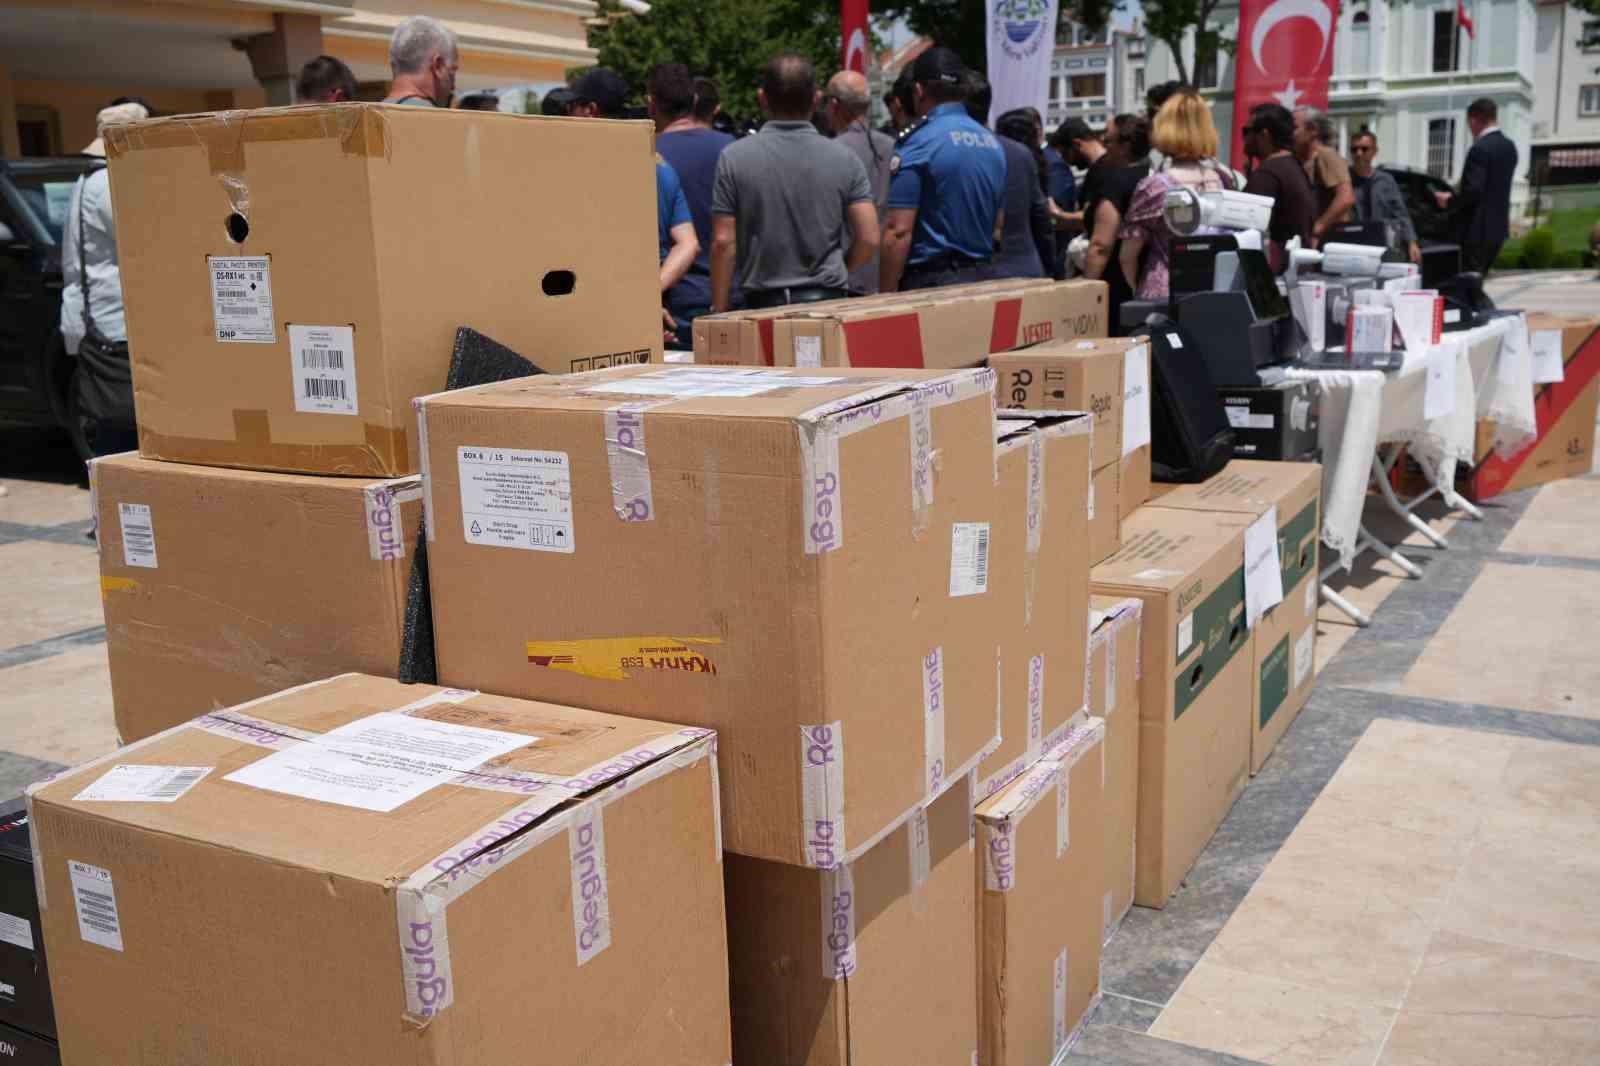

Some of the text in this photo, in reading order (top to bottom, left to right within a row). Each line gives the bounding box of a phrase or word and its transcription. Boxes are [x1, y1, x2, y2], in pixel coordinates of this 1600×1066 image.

[219, 330, 236, 338] DNP
[1008, 369, 1033, 409] Re
[621, 656, 644, 669] ESB
[1029, 655, 1042, 739] Regula
[574, 821, 602, 952] Regula
[404, 921, 447, 1017] gula
